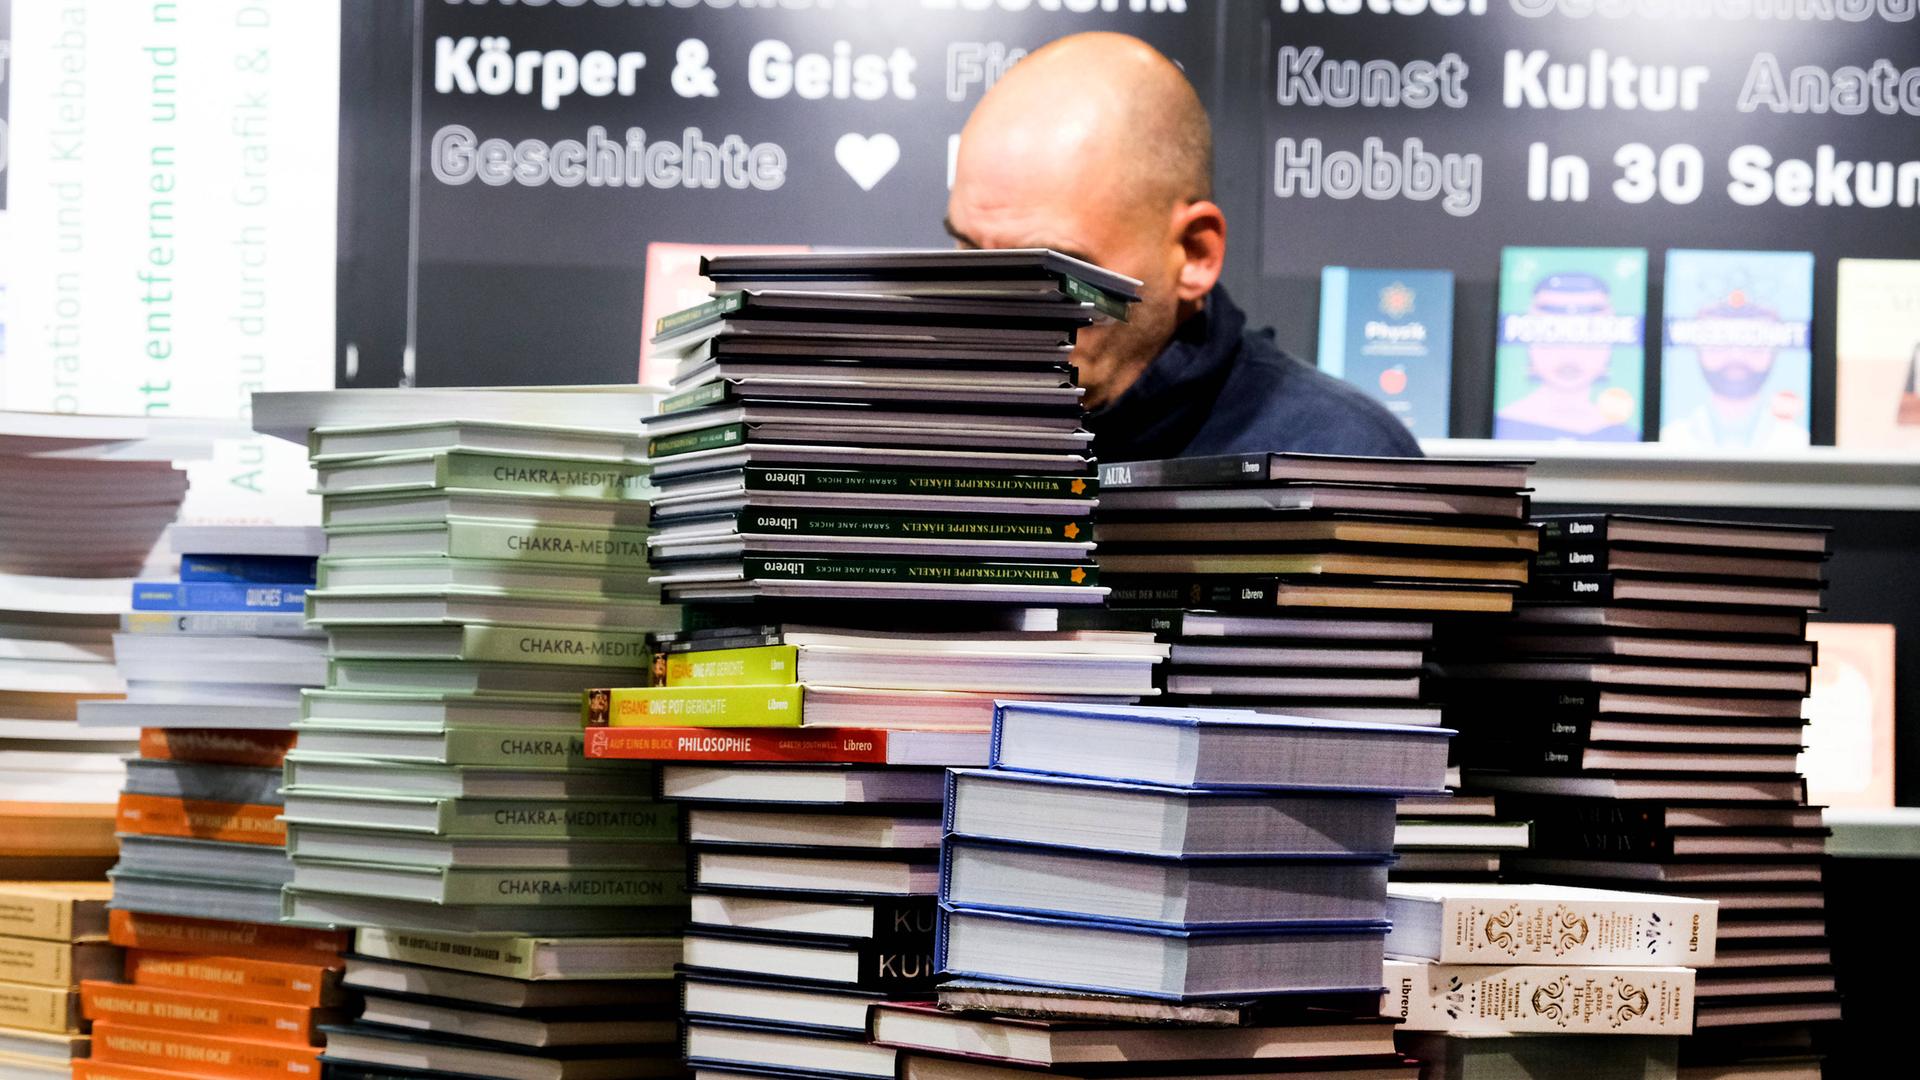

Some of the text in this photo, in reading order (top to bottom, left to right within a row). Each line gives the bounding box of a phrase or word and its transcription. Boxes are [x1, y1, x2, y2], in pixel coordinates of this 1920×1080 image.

[233, 48, 271, 74] &
[49, 0, 87, 162] Klebeba
[434, 35, 647, 111] Körper
[671, 38, 720, 98] &
[748, 38, 918, 101] Geist
[1277, 45, 1470, 109] Kunst
[1503, 49, 1710, 111] Kultur
[141, 46, 178, 124] und
[231, 90, 269, 207] Grafik
[431, 124, 787, 191] Geschichte
[1273, 136, 1920, 217] Hobby In 30 Sekun
[48, 181, 84, 253] und
[137, 145, 175, 361] entfernen
[229, 225, 268, 337] durch
[1364, 320, 1428, 344] Physik
[493, 466, 651, 490] CHAKRA-MEDITATIO
[765, 472, 806, 485] Librero
[817, 476, 842, 484] HICKS
[909, 478, 952, 489] HÄKELN
[954, 479, 1060, 490] WEIHNACHTSKRIPPE
[1104, 466, 1132, 485] AURA
[757, 517, 798, 530] Librero
[902, 522, 945, 534] HÄKELN
[947, 523, 1053, 535] WEIHNACHTSKRIPPE
[1569, 522, 1595, 534] Librero
[1569, 552, 1595, 563] Librero
[764, 561, 805, 575] Librero
[909, 567, 951, 578] HÄKELN
[954, 568, 1060, 579] WEIHNACHTSKRIPPE
[1242, 588, 1263, 600] Librero
[1573, 581, 1599, 592] Librero
[649, 699, 667, 715] ONE
[668, 699, 684, 714] POT
[685, 699, 727, 715] GERICHTE
[767, 698, 789, 711] Librero
[1551, 723, 1576, 734] Librero
[609, 739, 625, 749] AUF
[626, 739, 650, 749] EINEN
[651, 738, 674, 749] BLICK
[678, 736, 752, 752] PHILOSOPHIE
[843, 739, 873, 751] Librero
[1544, 751, 1569, 762] Librero
[494, 809, 657, 826] CHAKRA-MEDITATION
[498, 879, 664, 897] CHAKRA-MEDITATION
[1532, 907, 1543, 953] heitliche
[1543, 915, 1553, 945] Hexe
[1689, 914, 1700, 952] Librero
[1401, 978, 1412, 1017] Librero
[1573, 986, 1584, 1017] Hexe
[1584, 978, 1595, 1024] heitliche
[1605, 994, 1613, 1010] DIE
